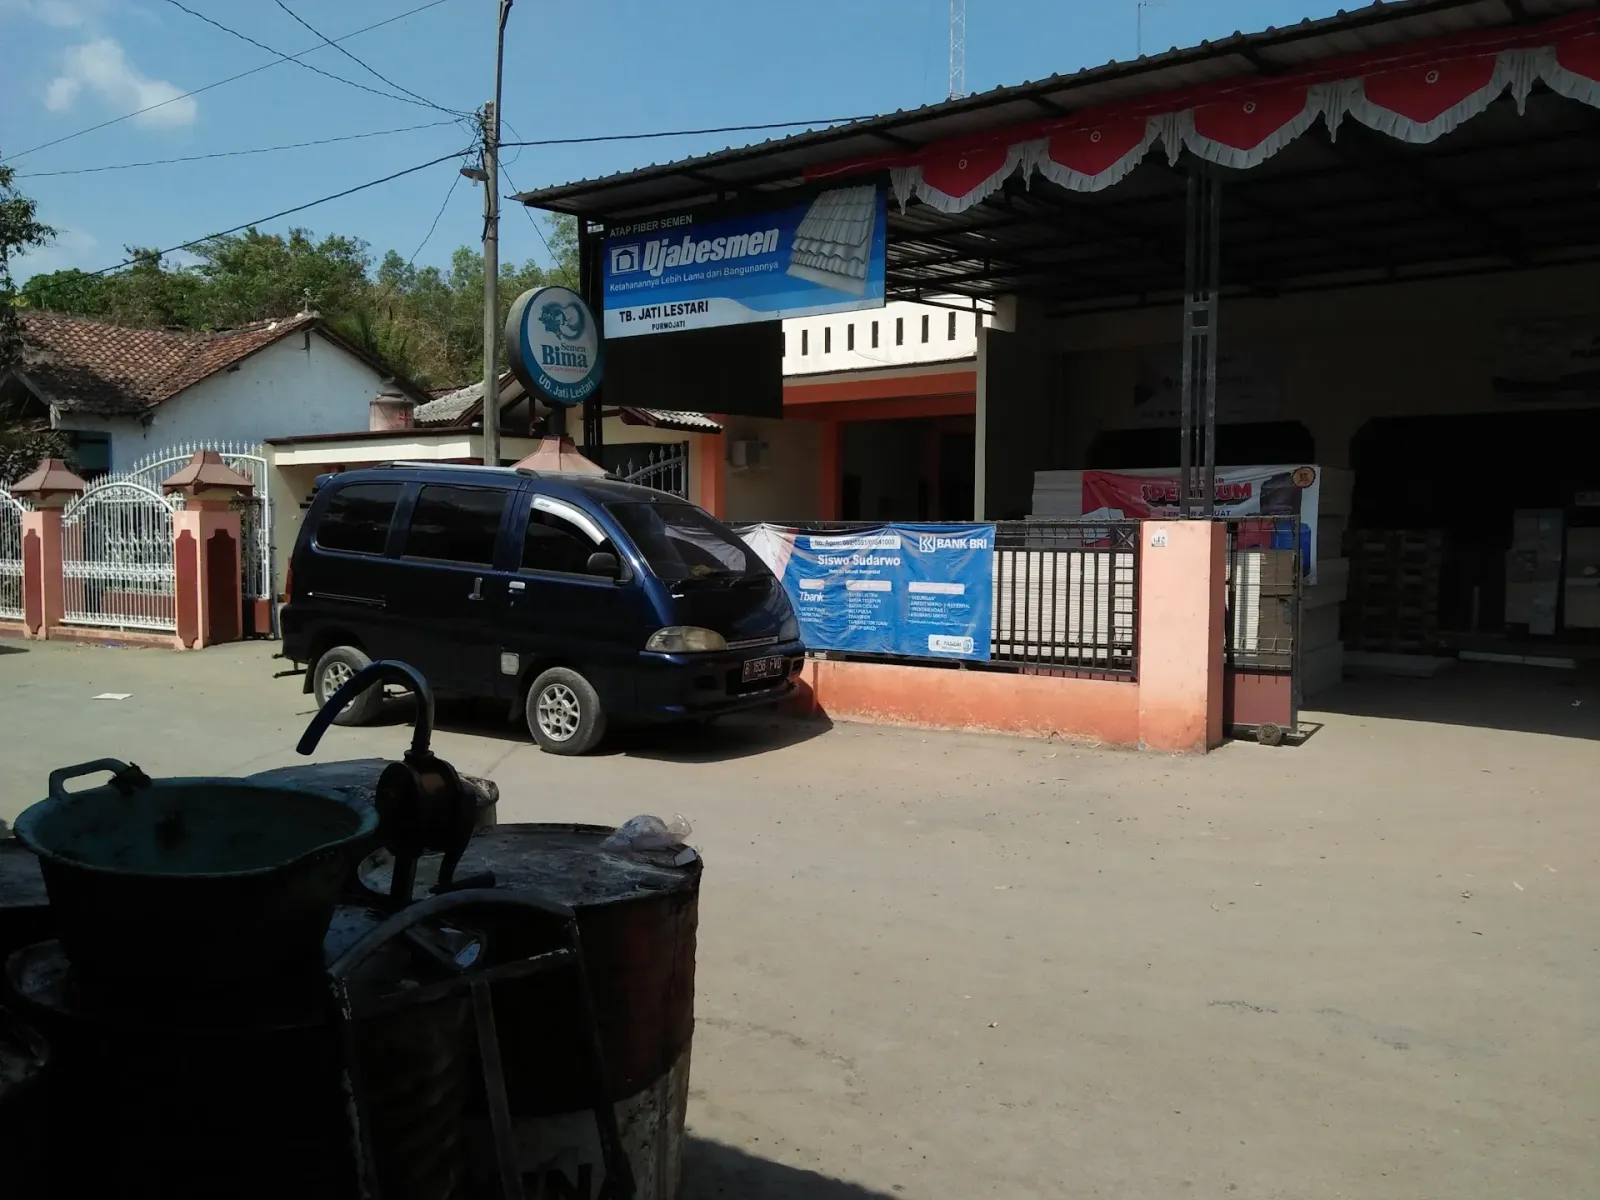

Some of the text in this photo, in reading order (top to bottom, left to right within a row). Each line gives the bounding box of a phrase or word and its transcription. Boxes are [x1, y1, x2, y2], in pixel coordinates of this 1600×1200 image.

[610, 214, 692, 238] ATAP FIBER SEMEN
[642, 228, 780, 277] Djabesmen
[609, 261, 779, 292] Ketahanannya Lebih Lama dari Bangunannya
[619, 300, 709, 324] TB. JATI LESTARI
[540, 344, 588, 369] Bima
[560, 342, 586, 353] Semen
[538, 374, 595, 399] UD. Jati Lestari
[936, 537, 987, 550] BANK BRI
[818, 554, 901, 568] Siswo Sudarwo
